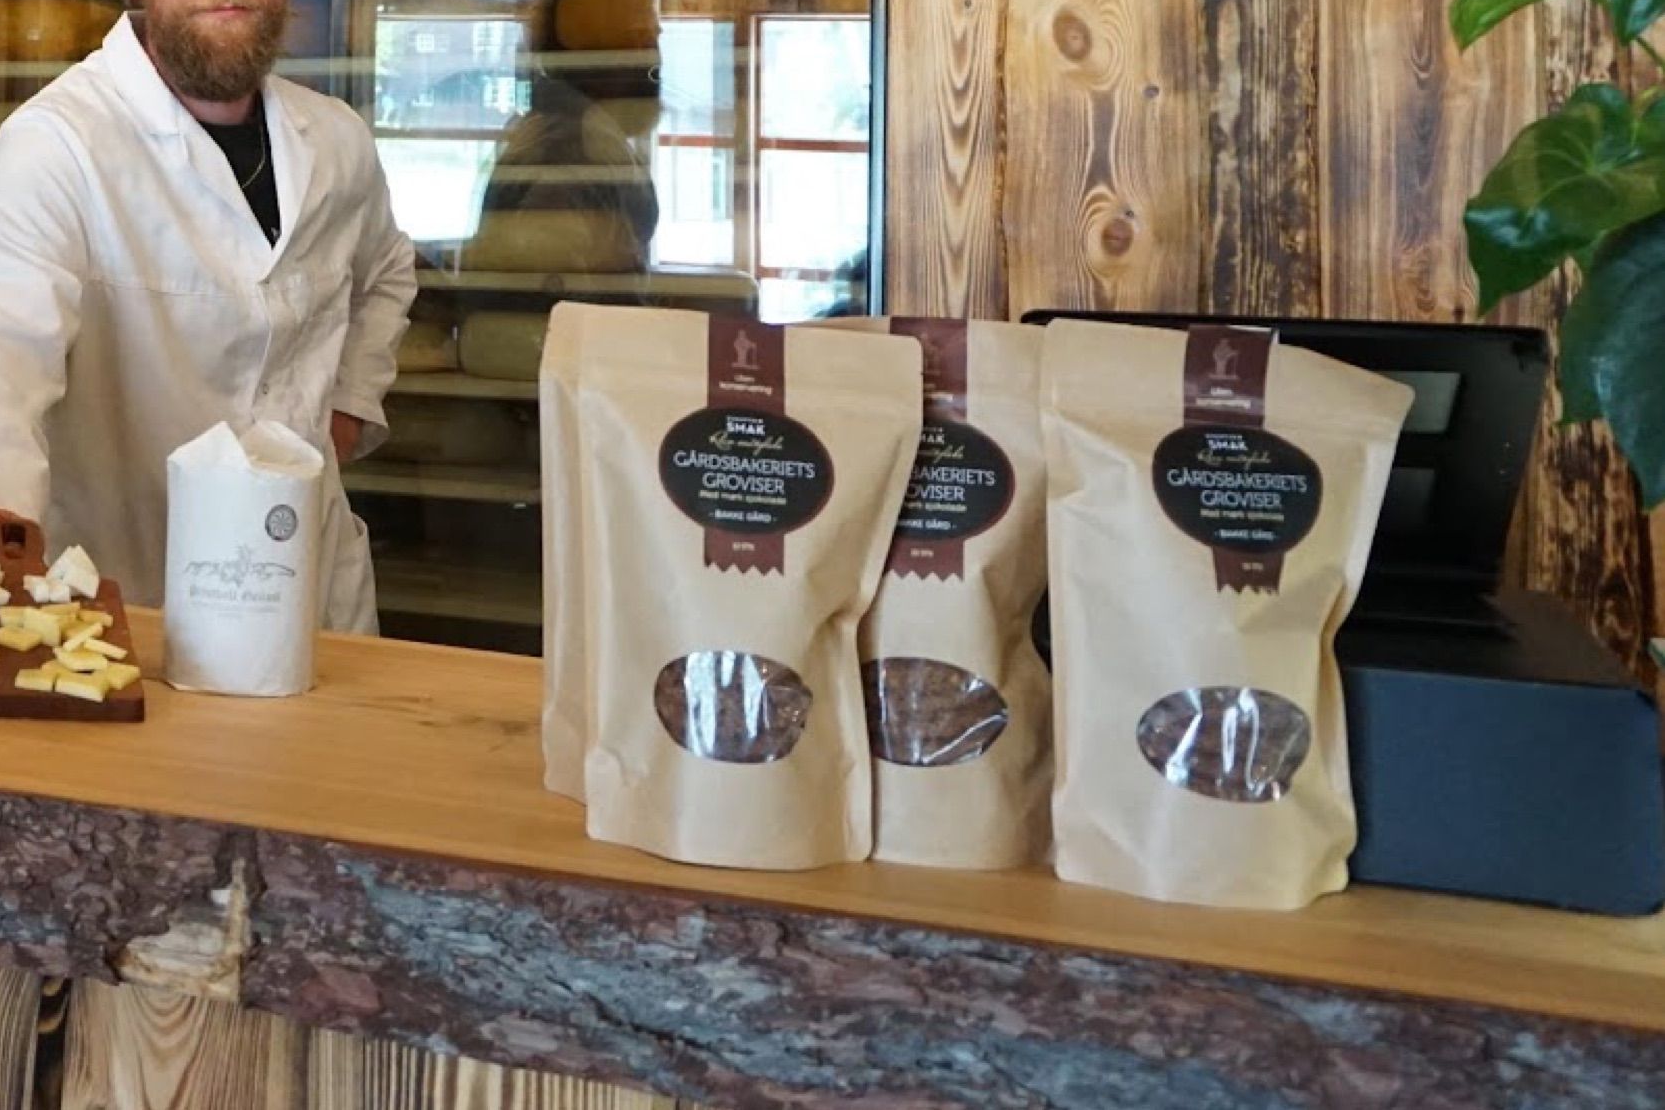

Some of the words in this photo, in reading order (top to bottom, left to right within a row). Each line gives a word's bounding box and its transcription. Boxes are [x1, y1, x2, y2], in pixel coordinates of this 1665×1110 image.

[672, 449, 816, 479] GÅRDSBAKERIETS
[701, 471, 785, 495] GROVISER
[1166, 466, 1309, 493] GÅRDSBAKERIETS
[1199, 489, 1283, 509] GROVISER
